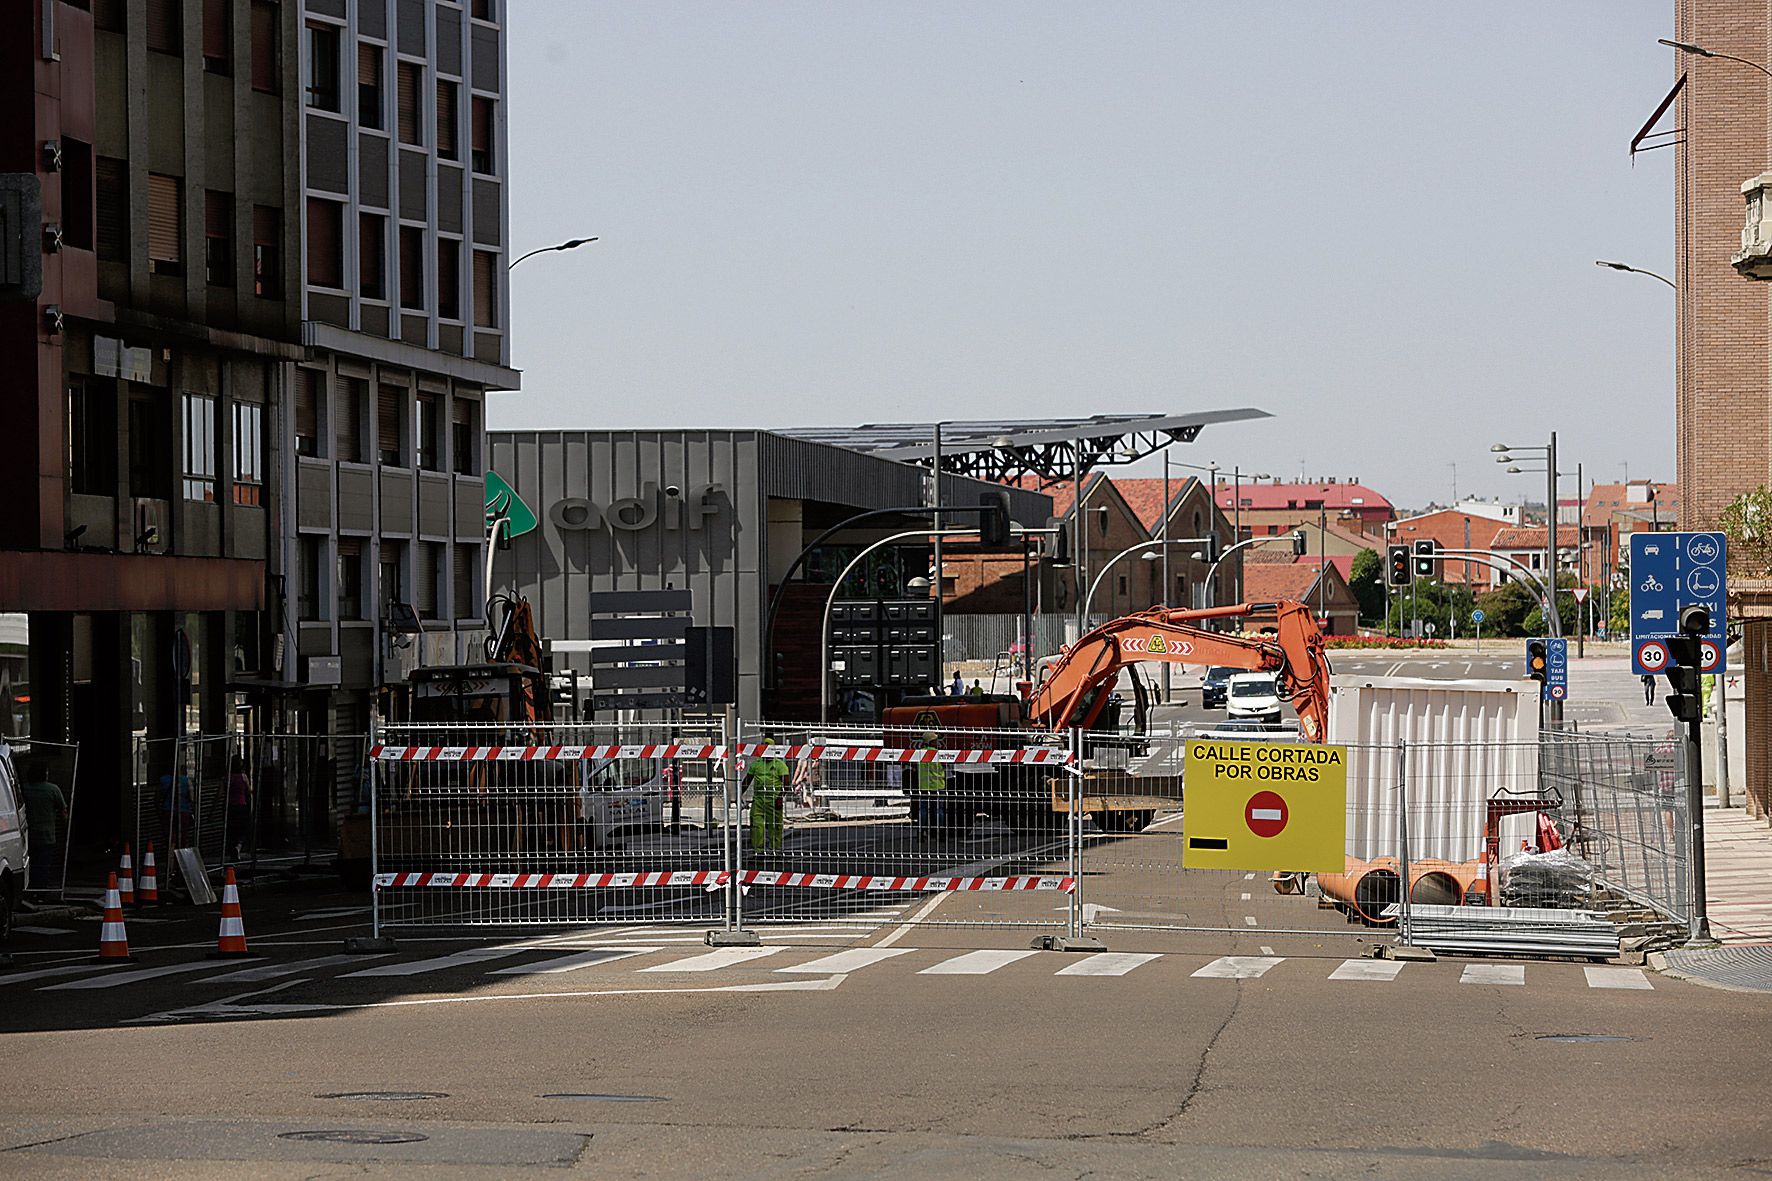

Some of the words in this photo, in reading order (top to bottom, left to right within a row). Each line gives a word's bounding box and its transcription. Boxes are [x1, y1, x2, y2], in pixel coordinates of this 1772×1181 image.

[549, 481, 723, 531] adif
[1644, 651, 1662, 661] 30
[1193, 745, 1251, 762] CALLE
[1256, 747, 1341, 765] CORTADA
[1215, 764, 1253, 780] POR
[1257, 765, 1319, 782] OBRAS
